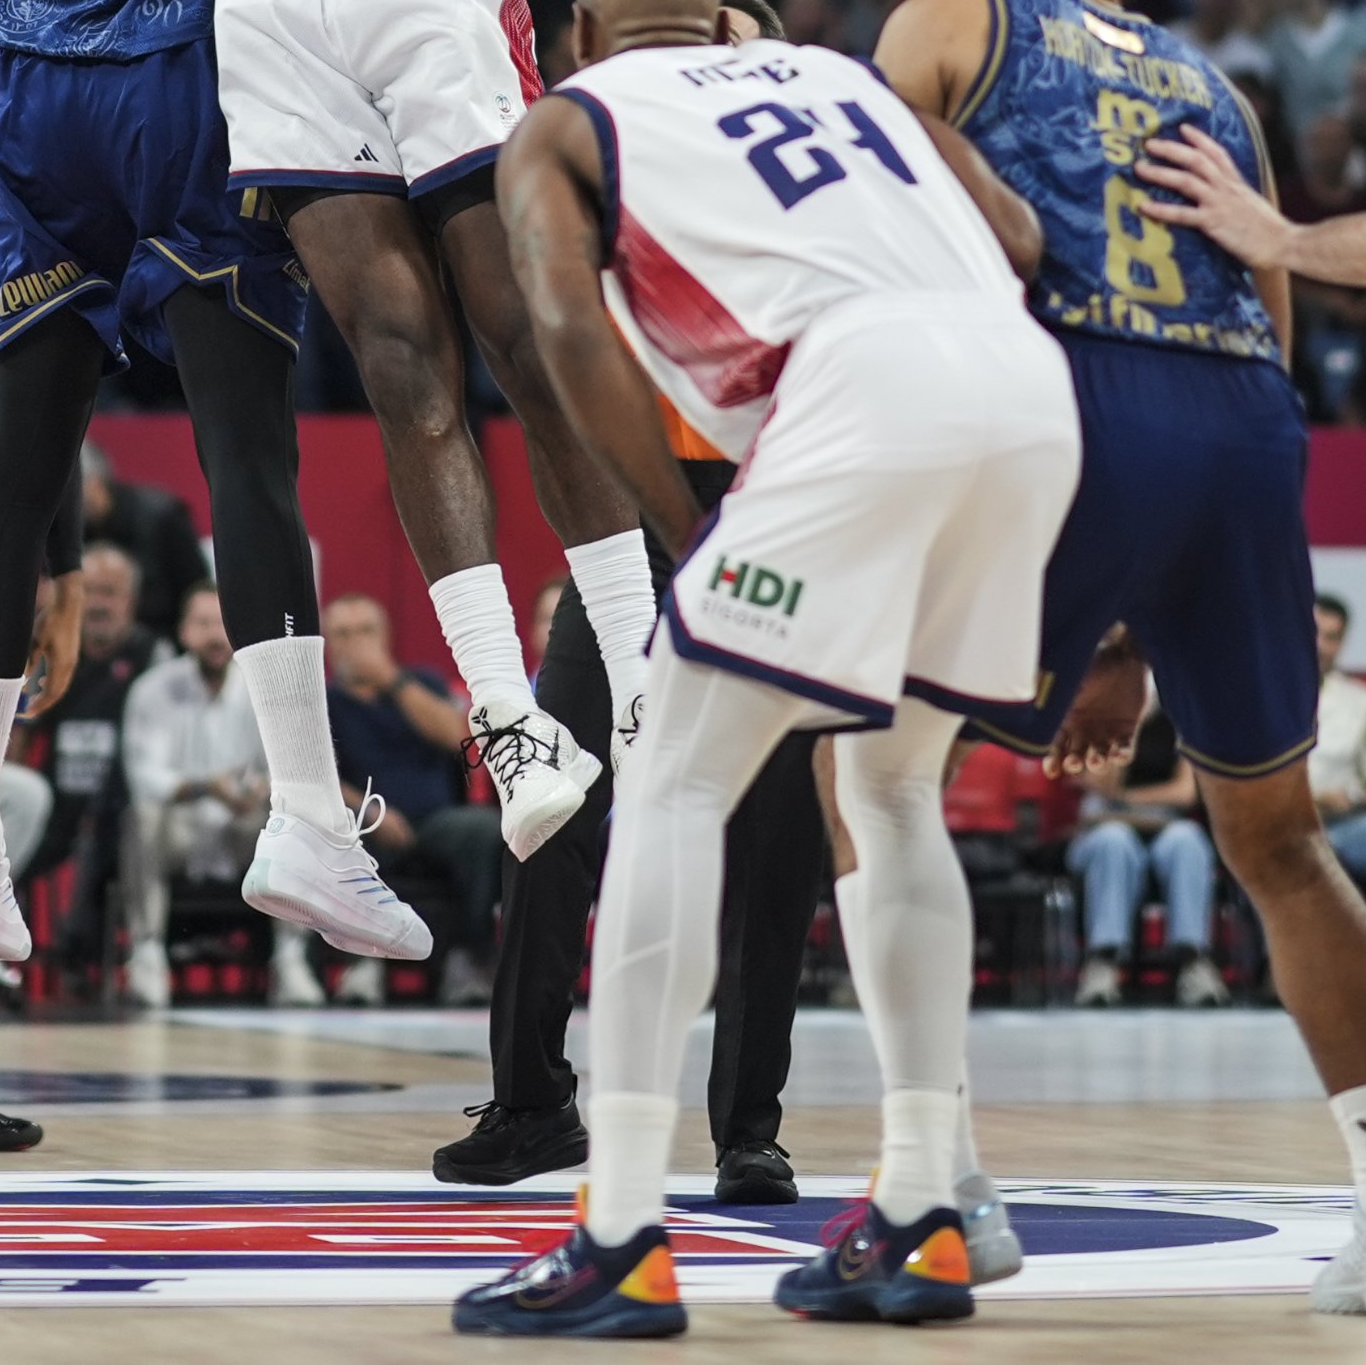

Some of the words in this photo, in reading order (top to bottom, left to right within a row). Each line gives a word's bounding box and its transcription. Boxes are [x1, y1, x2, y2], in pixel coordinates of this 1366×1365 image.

[717, 101, 920, 211] 24
[1104, 174, 1187, 308] 8
[708, 555, 804, 617] HDI
